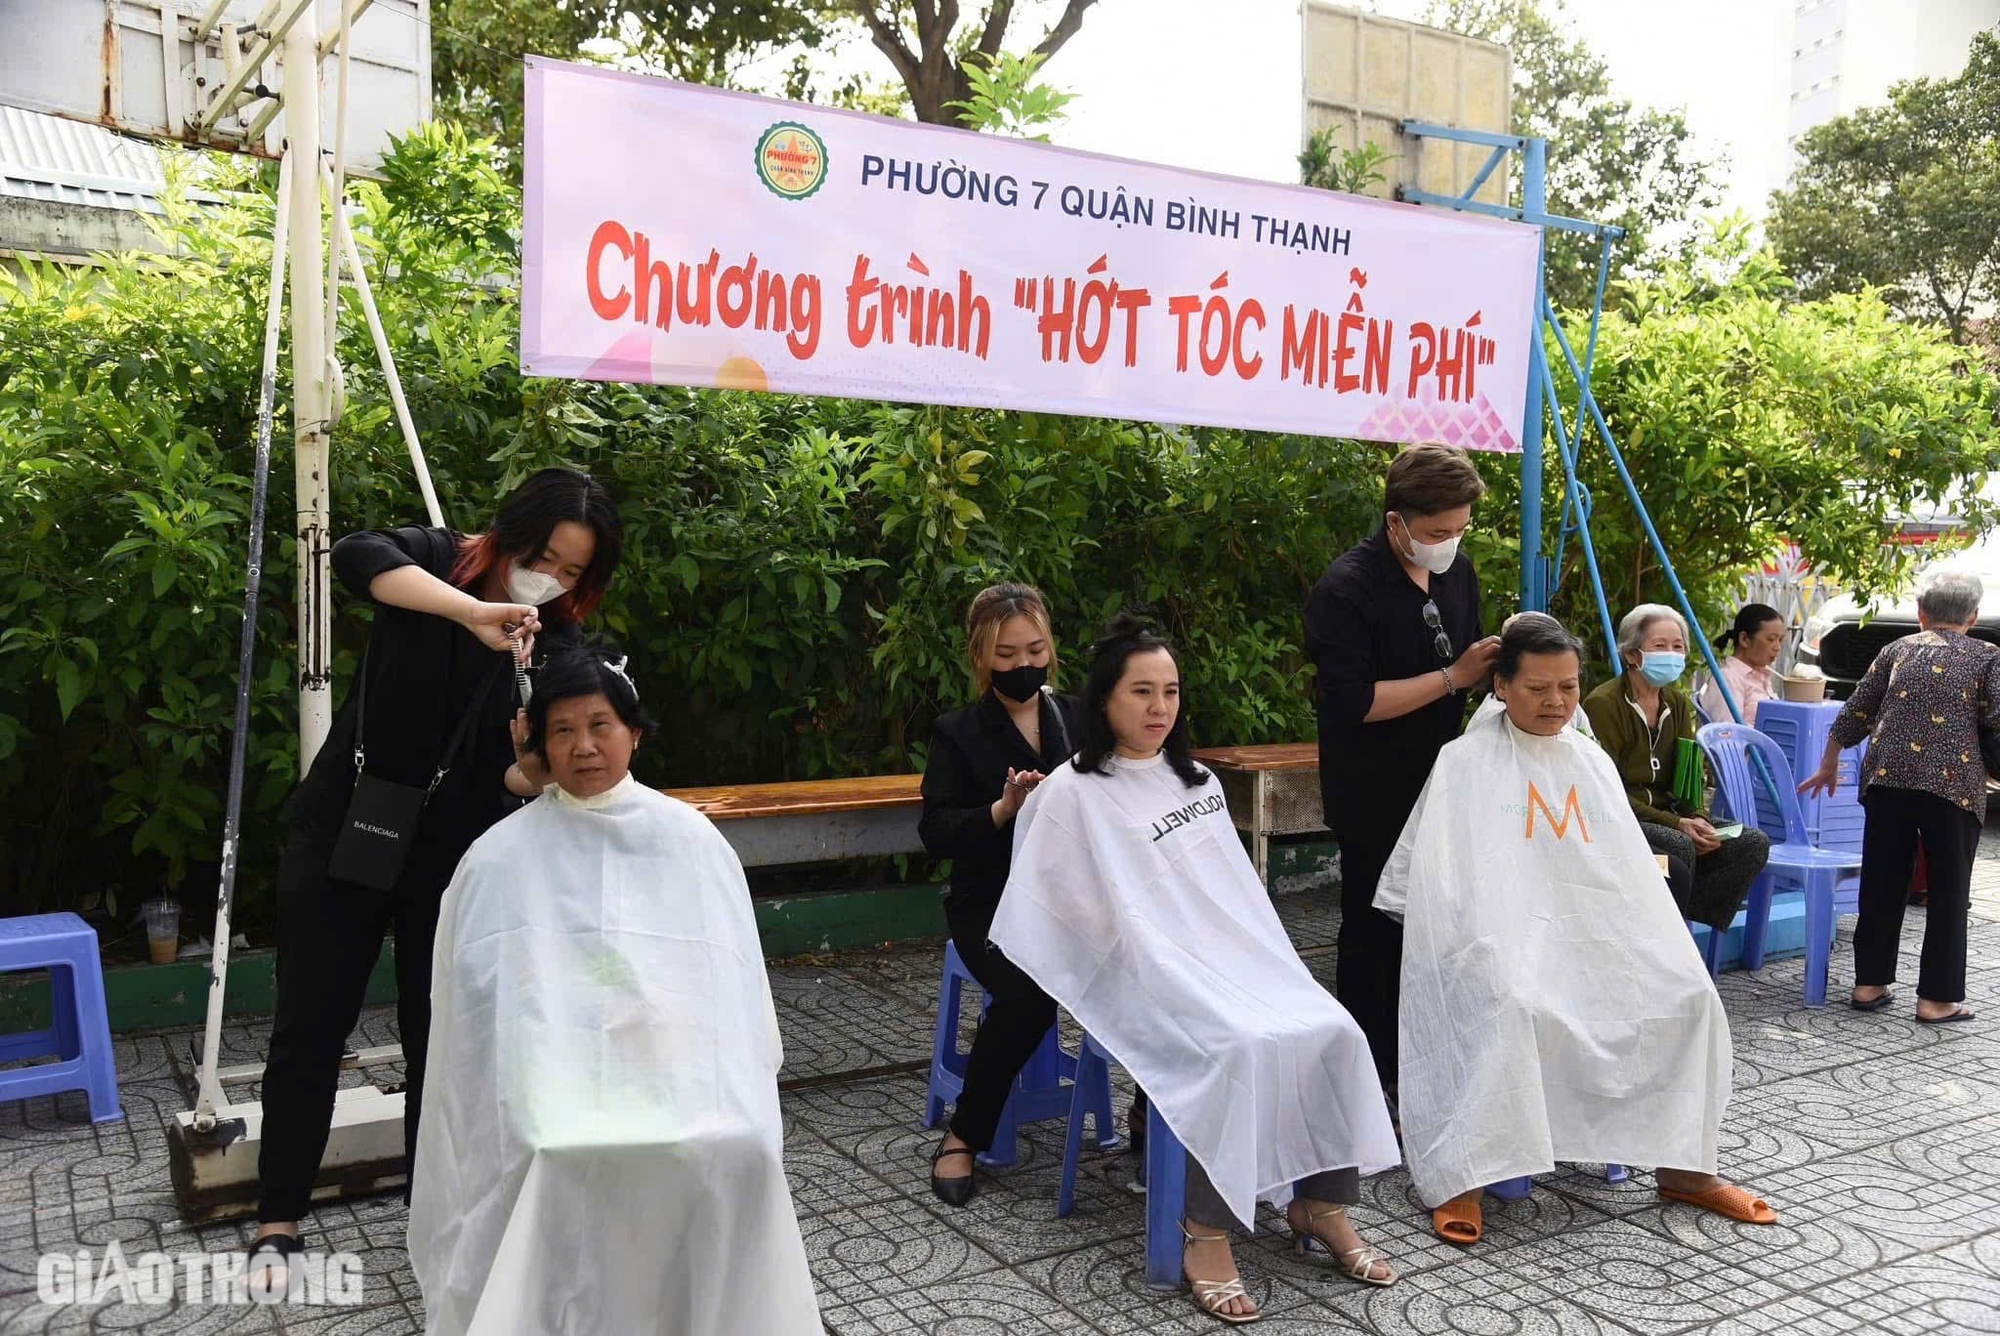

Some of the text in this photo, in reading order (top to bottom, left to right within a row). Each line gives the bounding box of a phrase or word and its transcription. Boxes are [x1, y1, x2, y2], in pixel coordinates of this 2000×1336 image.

[810, 155, 817, 165] 7
[861, 154, 1351, 256] PHƯỜNG 7 QUẬN BÌNH THẠNH
[586, 220, 822, 360] Chương
[846, 252, 991, 360] trình
[1168, 270, 1266, 380] TÓC
[1281, 267, 1393, 395] MIỄN
[353, 820, 399, 839] BALENCIAGA
[1526, 780, 1592, 843] M
